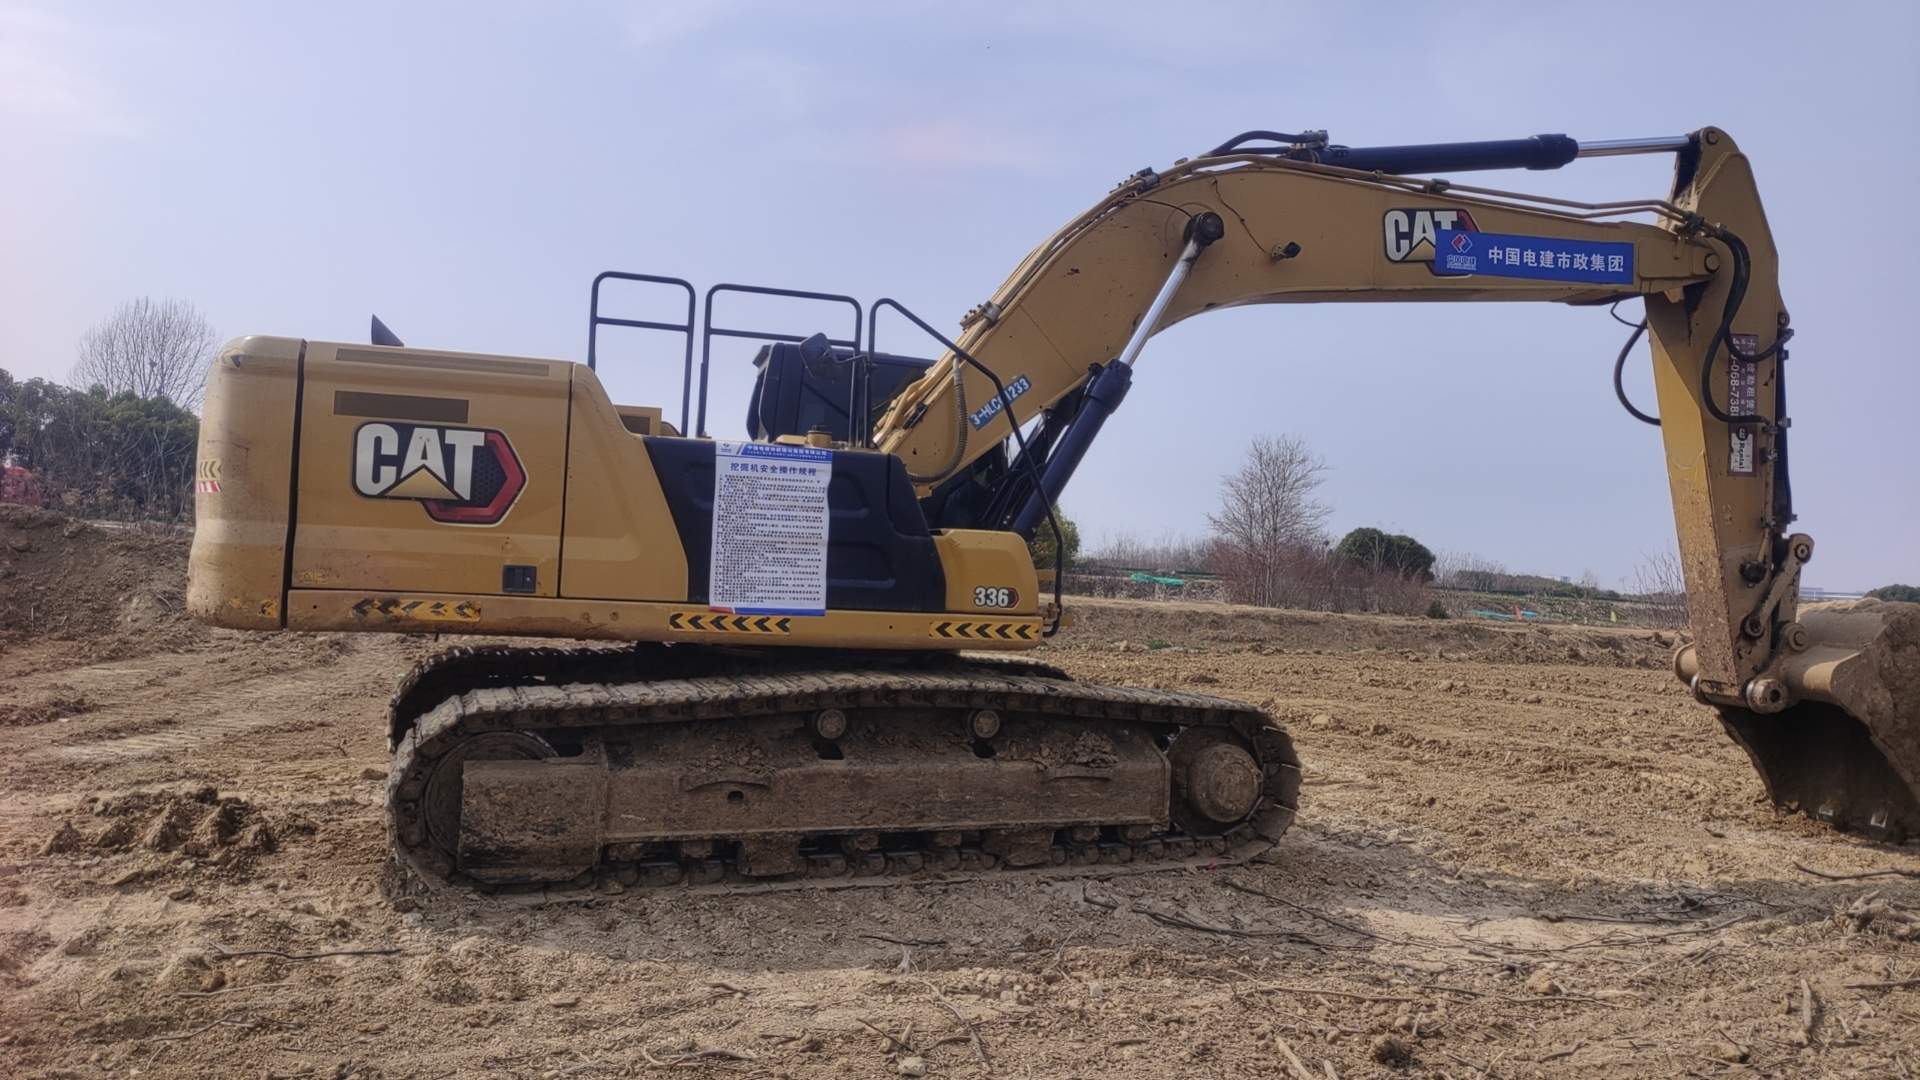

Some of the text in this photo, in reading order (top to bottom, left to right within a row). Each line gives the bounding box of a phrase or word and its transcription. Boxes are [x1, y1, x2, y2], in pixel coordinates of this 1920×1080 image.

[1384, 210, 1458, 262] CAT
[1488, 246, 1625, 273] 中国电建市政集团
[354, 422, 486, 501] CAT
[730, 462, 817, 476] 挖掘机安全操作规程
[975, 587, 1009, 607] 336
